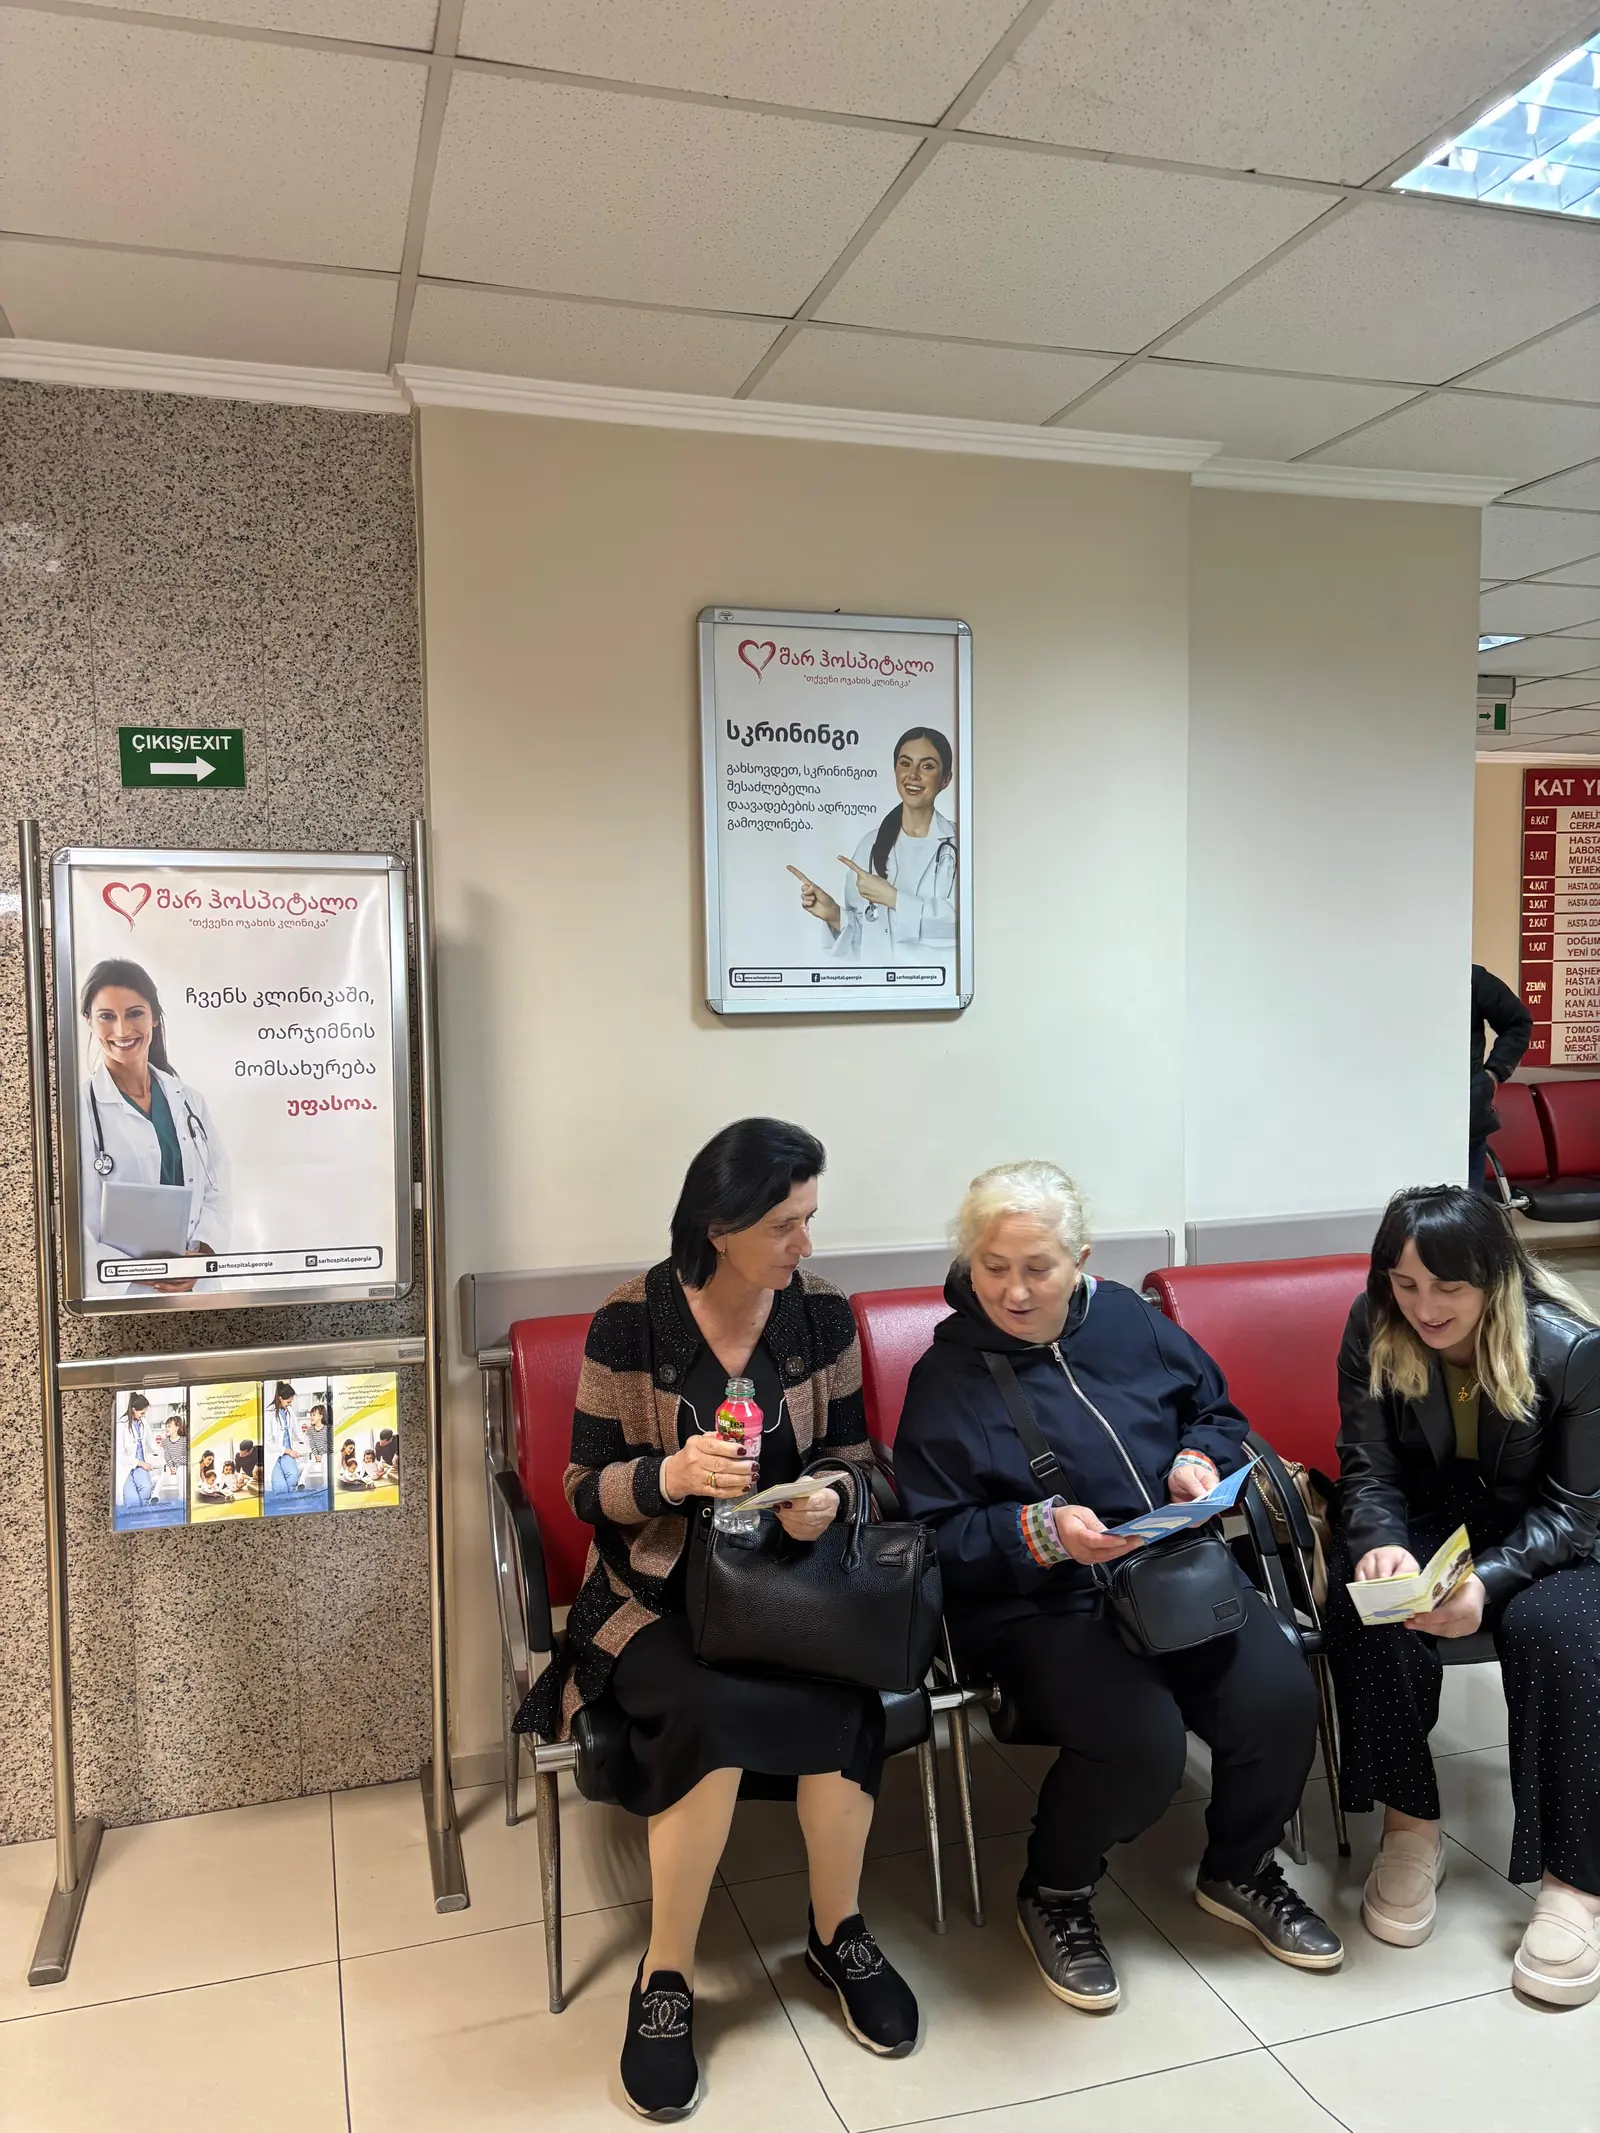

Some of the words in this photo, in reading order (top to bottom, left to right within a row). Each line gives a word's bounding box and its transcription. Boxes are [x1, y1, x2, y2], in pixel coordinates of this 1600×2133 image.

[780, 647, 814, 666] შარ
[820, 650, 934, 676] ჰოსპიტალი
[726, 719, 859, 751] სკრინინგი
[132, 734, 232, 753] ÇIKIŞ/EXIT
[726, 762, 801, 777] გახსოვდეთ,
[803, 765, 877, 780] სკრინინგით
[727, 780, 820, 796] შესაძლებელია
[1534, 779, 1575, 796] KAT
[727, 800, 815, 813] დაავადებების
[818, 801, 876, 816] ადრეული
[728, 816, 813, 831] გამოვლინება.
[1530, 816, 1549, 825] 6.KAT
[1530, 851, 1548, 860] 5.KAT
[1529, 881, 1548, 890] 4.KAT
[156, 888, 201, 909] შარ
[208, 890, 358, 916] ჰოსპიტალი
[1529, 900, 1548, 909] 3.KAT
[1568, 899, 1588, 907] HASTA
[1529, 918, 1547, 927] 2.KAT
[1567, 919, 1587, 928] HASTA
[1529, 942, 1547, 951] 1.KAT
[1568, 947, 1588, 956] YENİ
[1526, 980, 1546, 991] ZEMİN
[186, 987, 247, 1008] ჩვენს
[253, 987, 374, 1008] კლინიკაში,
[1528, 995, 1542, 1004] KAT
[1565, 1000, 1585, 1008] KAN
[1587, 999, 1600, 1007] AL
[1564, 1010, 1594, 1018] HASTA
[258, 1022, 375, 1044] თარჯიმნის
[1566, 1026, 1600, 1034] TOMOG
[1564, 1044, 1598, 1052] MESCİT
[1565, 1054, 1598, 1062] TEKNİK
[235, 1059, 376, 1079] მომსახურება
[287, 1095, 377, 1116] უფასოა.
[319, 1256, 372, 1264] sarhospital.georgia
